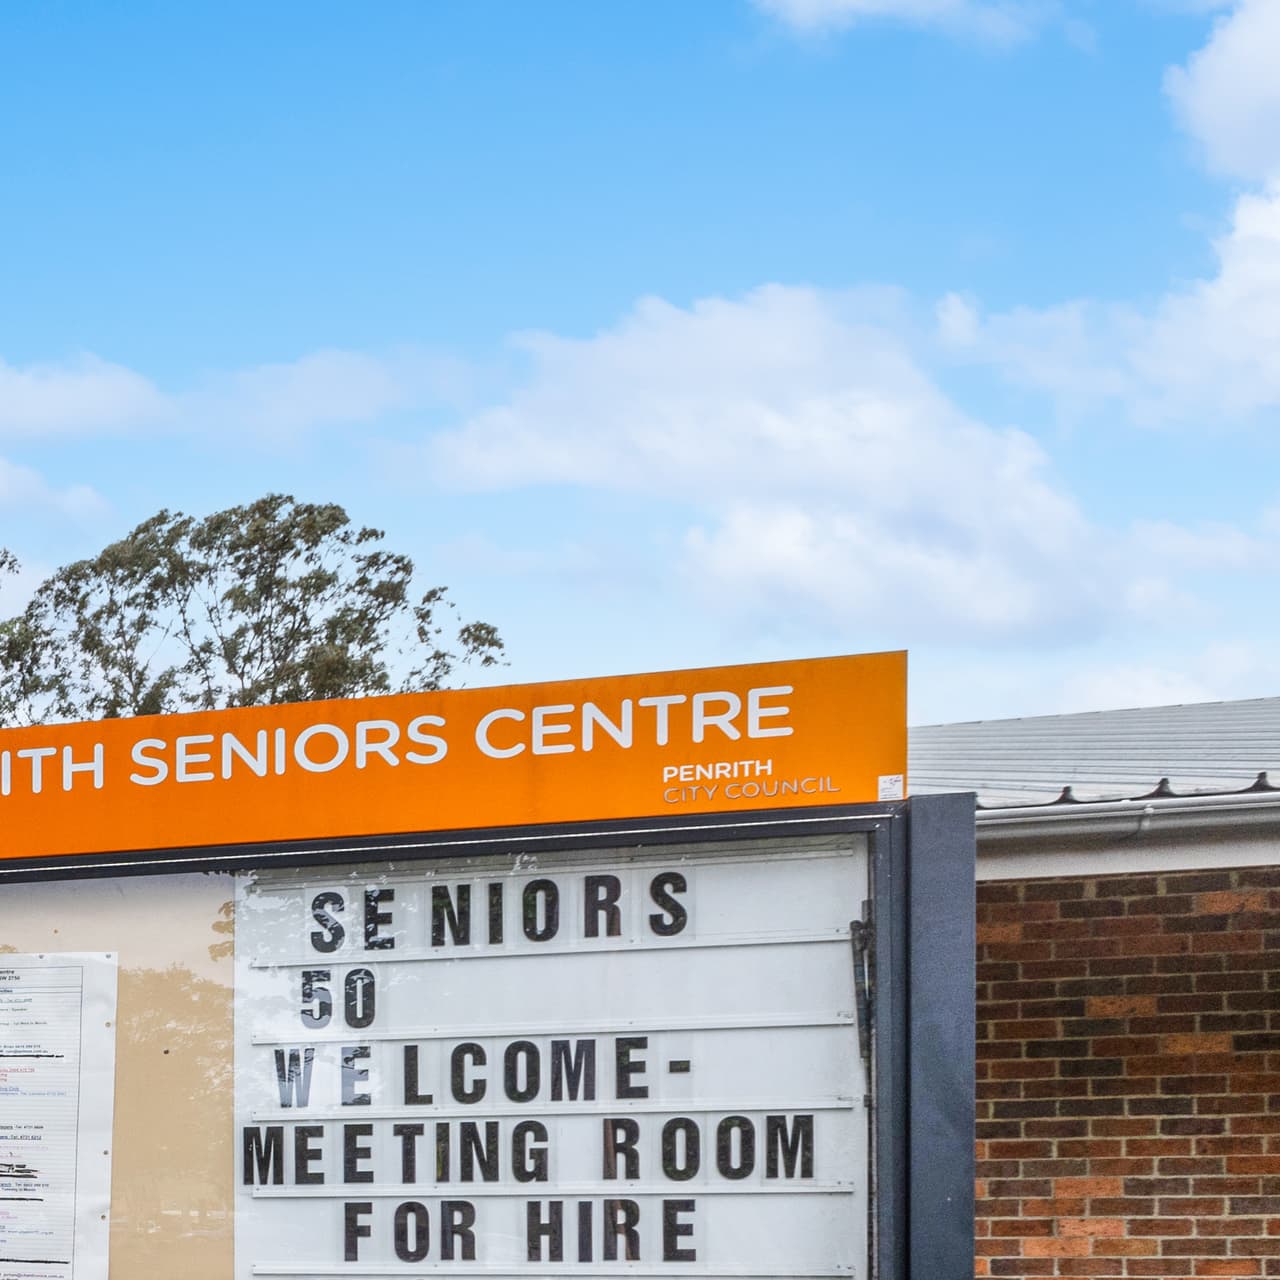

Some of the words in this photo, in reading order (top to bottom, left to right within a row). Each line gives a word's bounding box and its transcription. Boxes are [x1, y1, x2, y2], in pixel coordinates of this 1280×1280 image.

[129, 715, 448, 786] SENIORS
[474, 685, 794, 759] CENTRE
[662, 759, 773, 784] PENRITH
[663, 783, 719, 804] CITY
[724, 776, 840, 800] COUNCIL
[298, 967, 377, 1030] 50
[243, 1120, 549, 1186] MEETING
[602, 1114, 815, 1181] ROOM
[344, 1200, 477, 1263] FOR
[527, 1199, 697, 1262] HIRE
